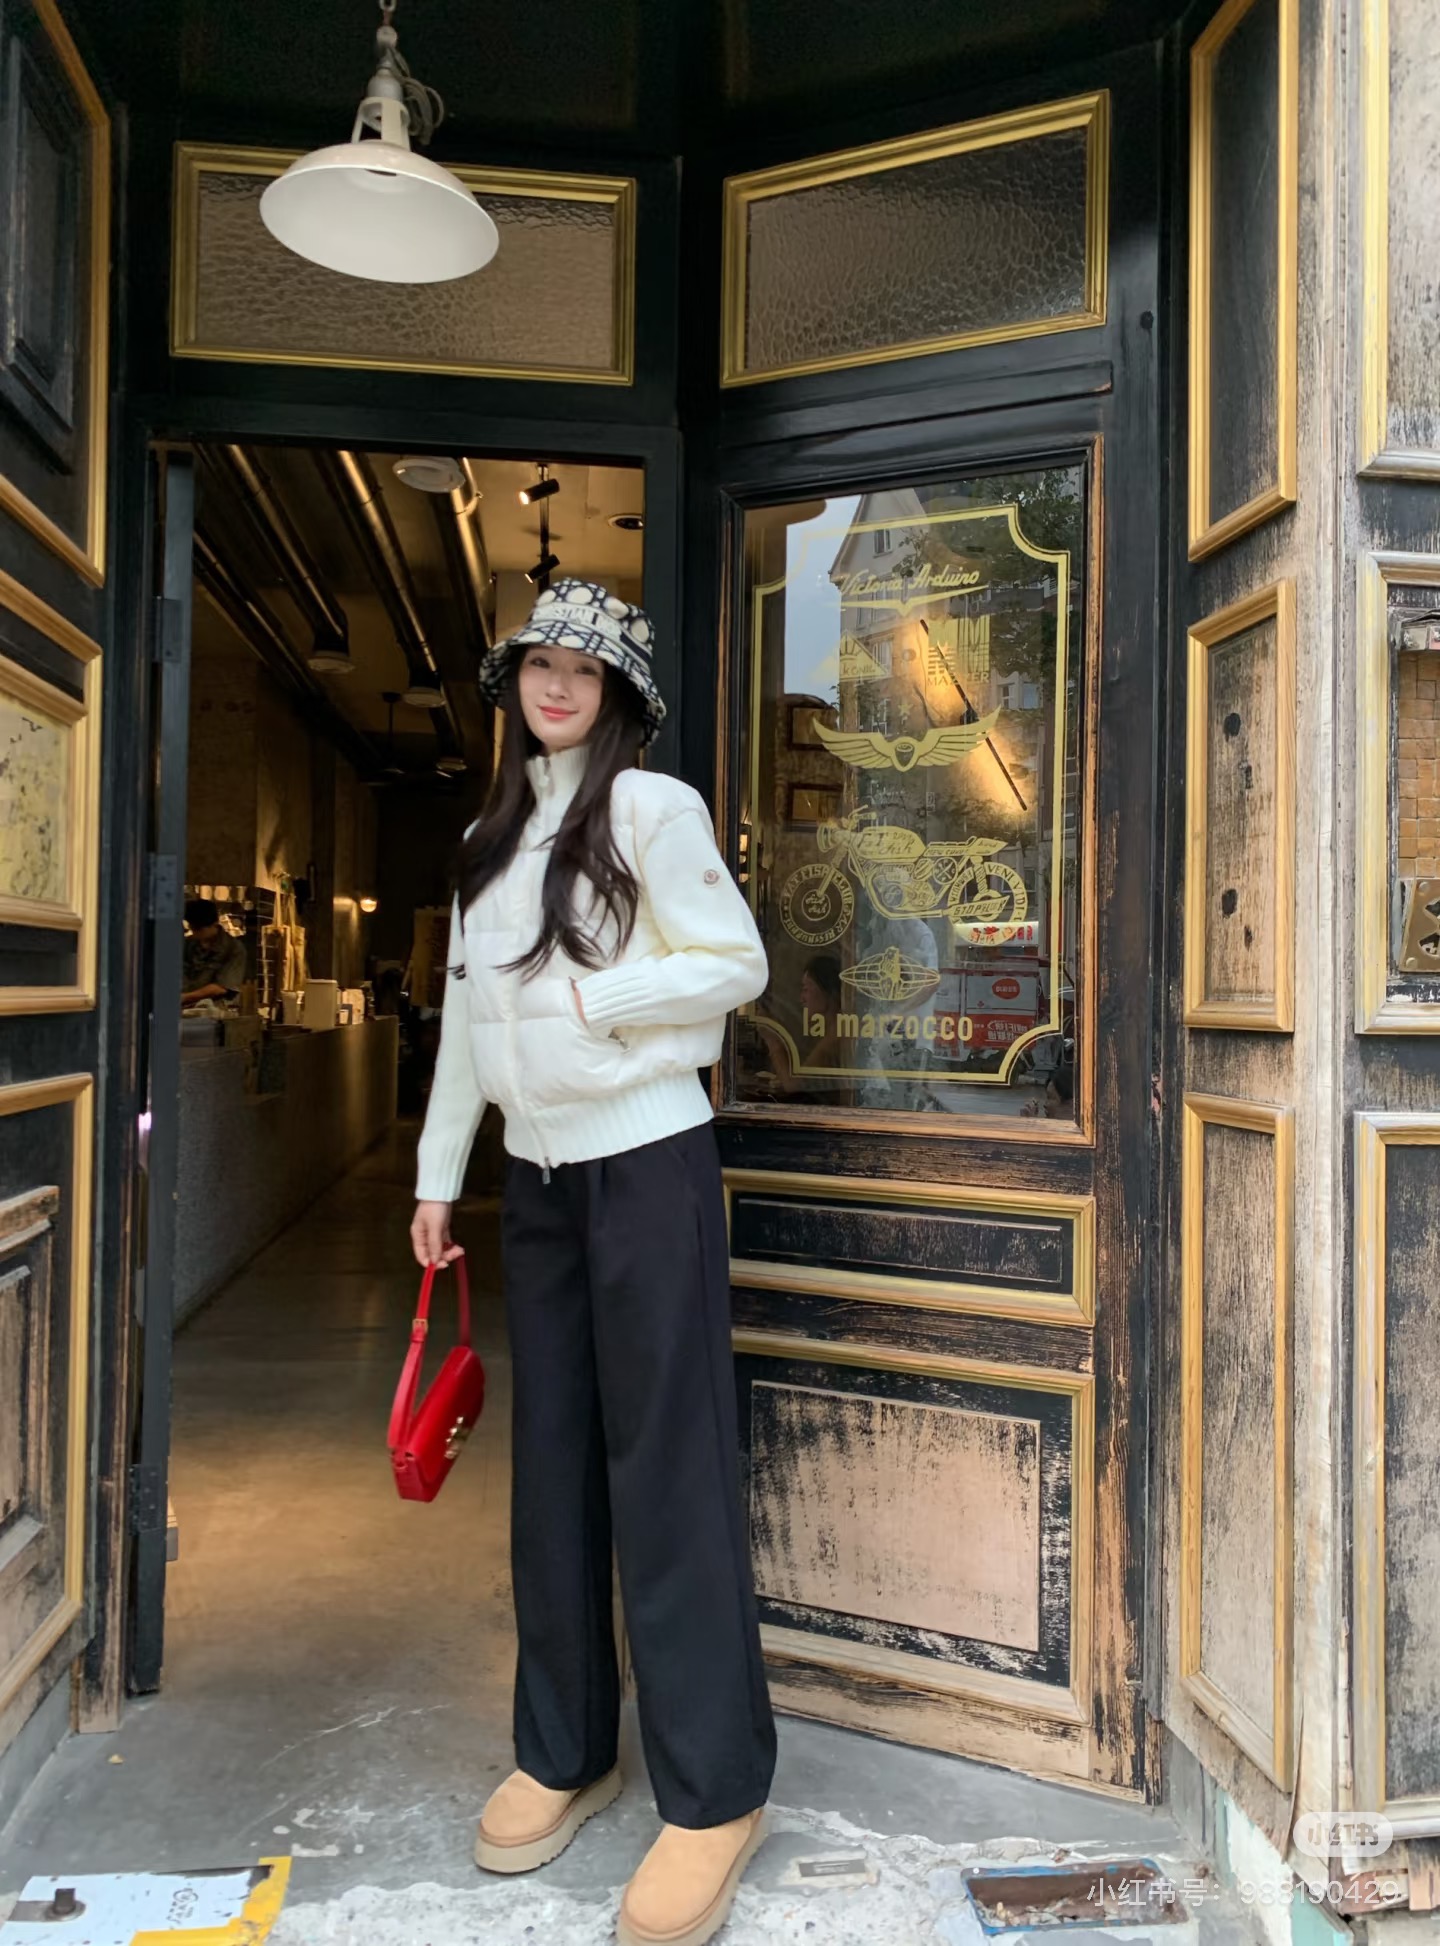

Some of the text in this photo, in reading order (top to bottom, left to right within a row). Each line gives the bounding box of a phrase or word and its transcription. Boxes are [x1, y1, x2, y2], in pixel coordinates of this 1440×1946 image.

[841, 562, 980, 595] Victoria Arduino
[927, 670, 989, 687] MAER
[987, 863, 1014, 881] VENI
[1013, 881, 1026, 910] VIDI
[803, 1007, 826, 1037] la
[836, 1012, 973, 1042] marzocco
